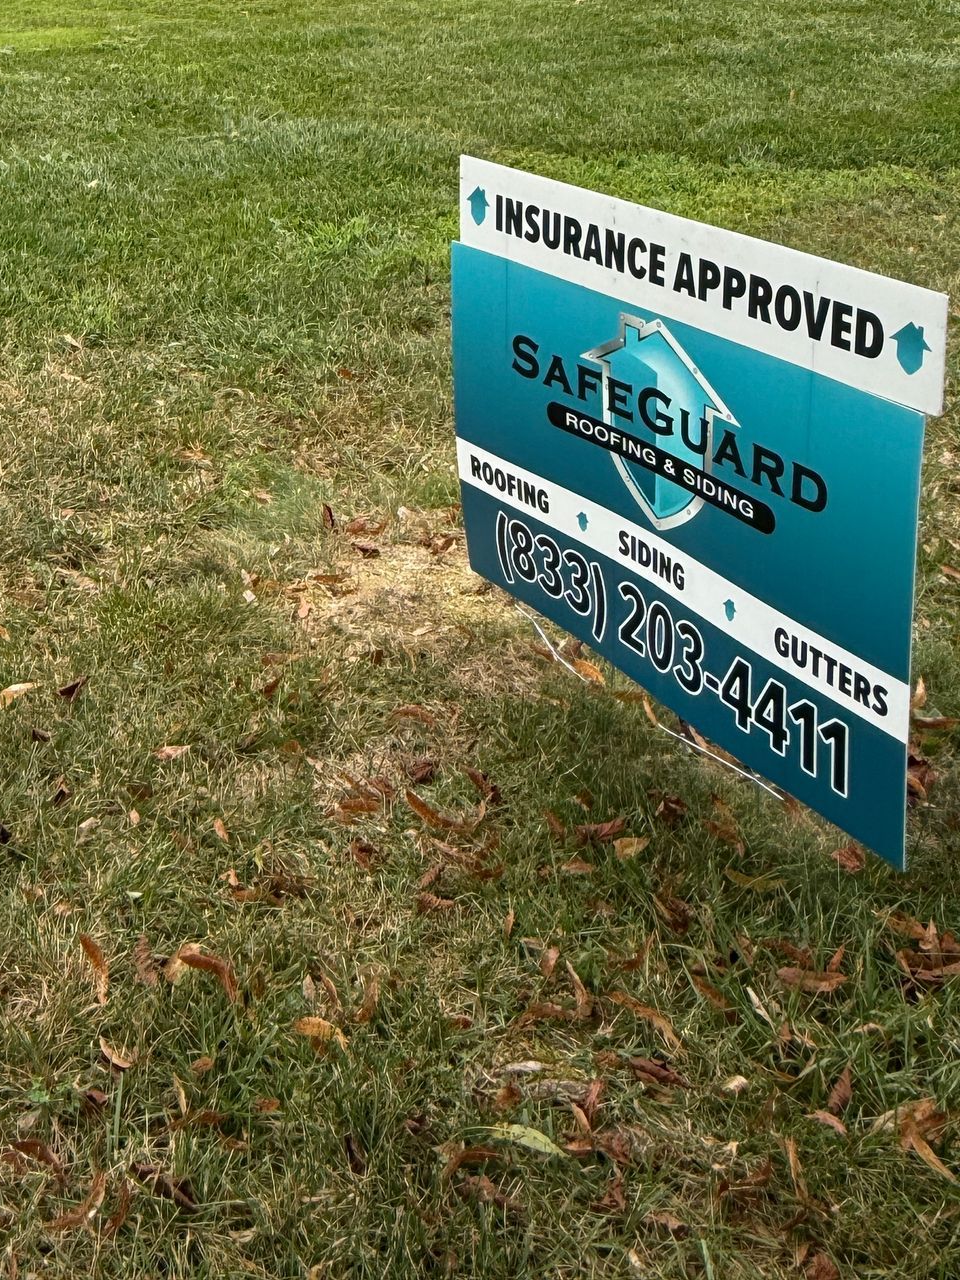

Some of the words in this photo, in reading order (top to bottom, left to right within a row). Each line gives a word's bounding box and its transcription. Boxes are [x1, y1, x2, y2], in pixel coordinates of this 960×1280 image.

[495, 194, 666, 286] INSURANCE
[673, 253, 885, 359] APPROVED
[511, 334, 829, 513] SAFEGUARD
[565, 412, 656, 475] ROOFING
[664, 458, 676, 477] &
[682, 467, 756, 519] SIDING
[470, 455, 550, 515] ROOFING
[618, 530, 686, 592] SIDING
[496, 510, 607, 643] (833)
[617, 581, 849, 799] 203-4411
[773, 627, 889, 718] GUTTERS
